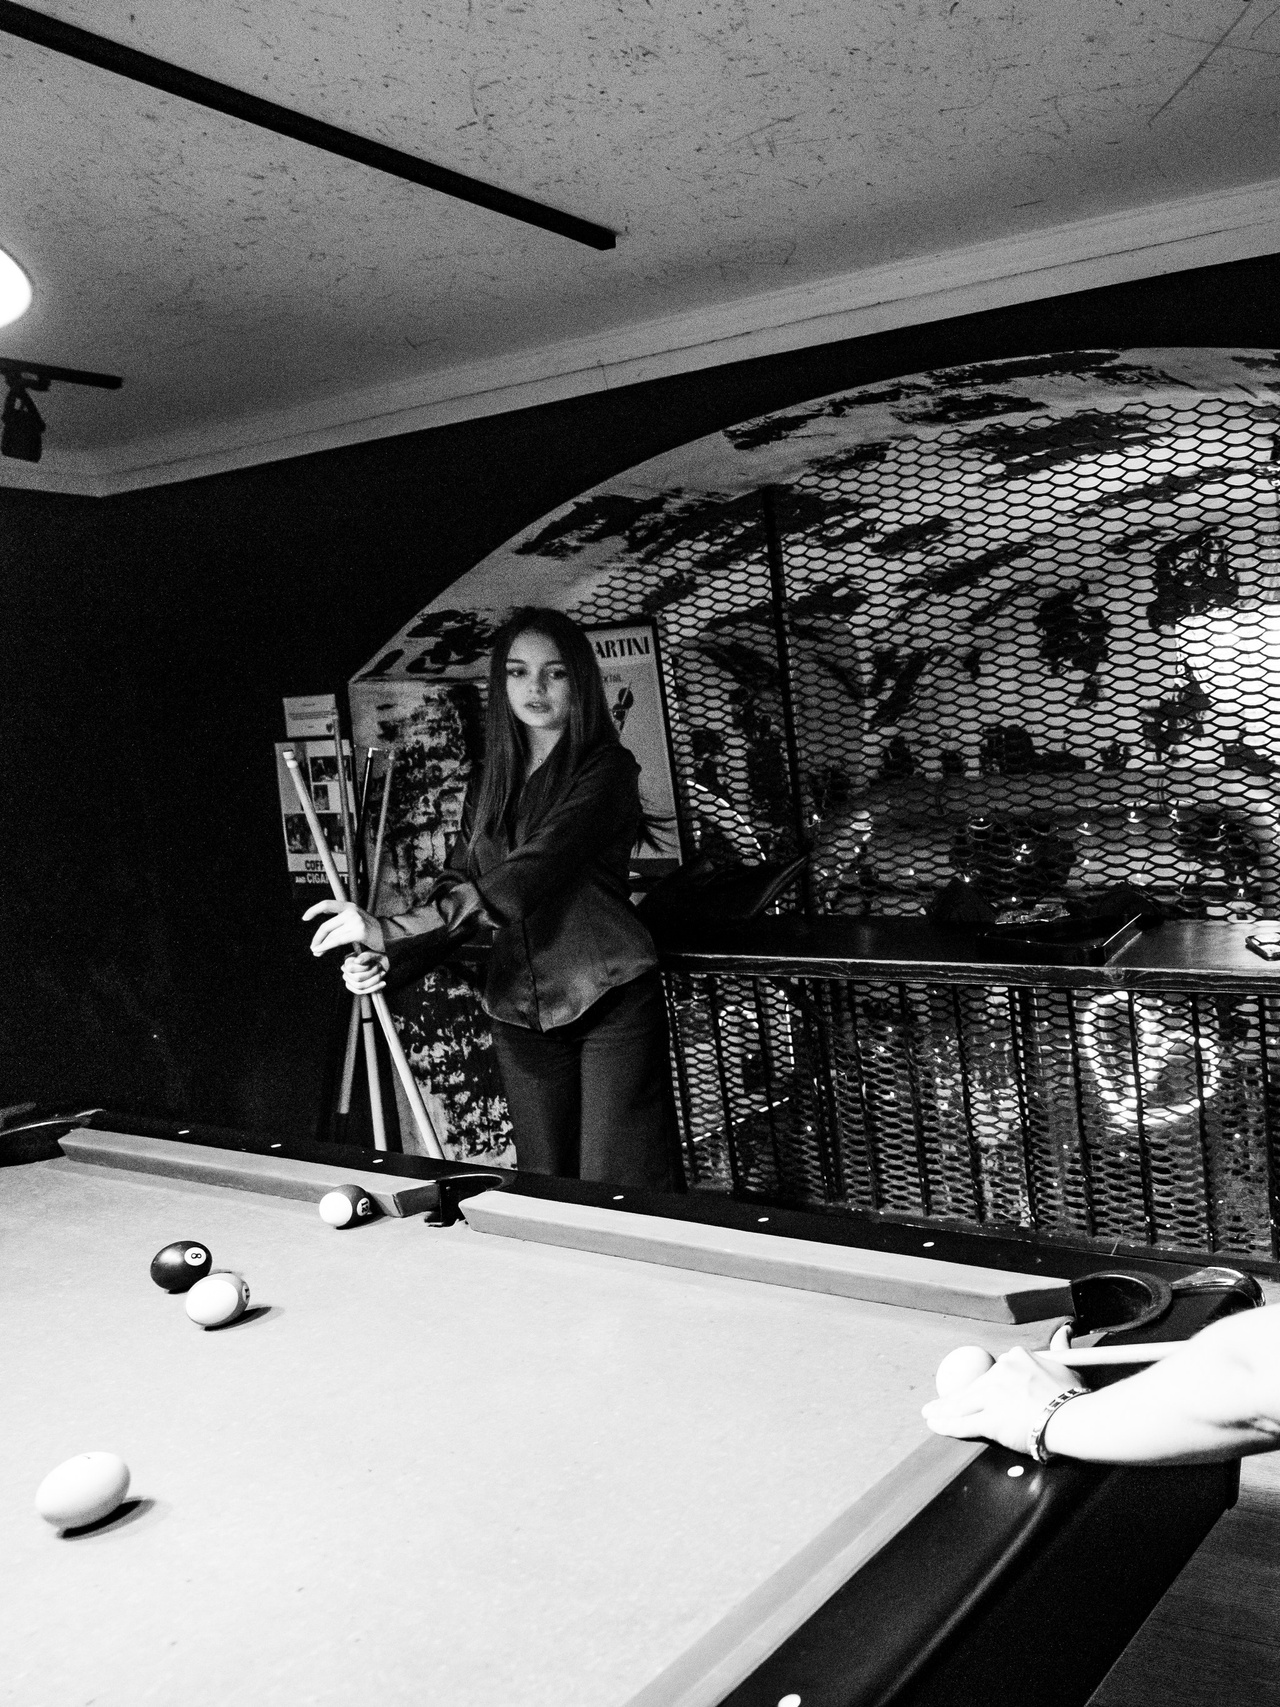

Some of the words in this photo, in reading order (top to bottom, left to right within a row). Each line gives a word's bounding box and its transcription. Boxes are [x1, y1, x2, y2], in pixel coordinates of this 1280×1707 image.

[595, 636, 650, 659] ARTINI
[304, 859, 324, 871] COFF
[190, 1252, 202, 1260] 8
